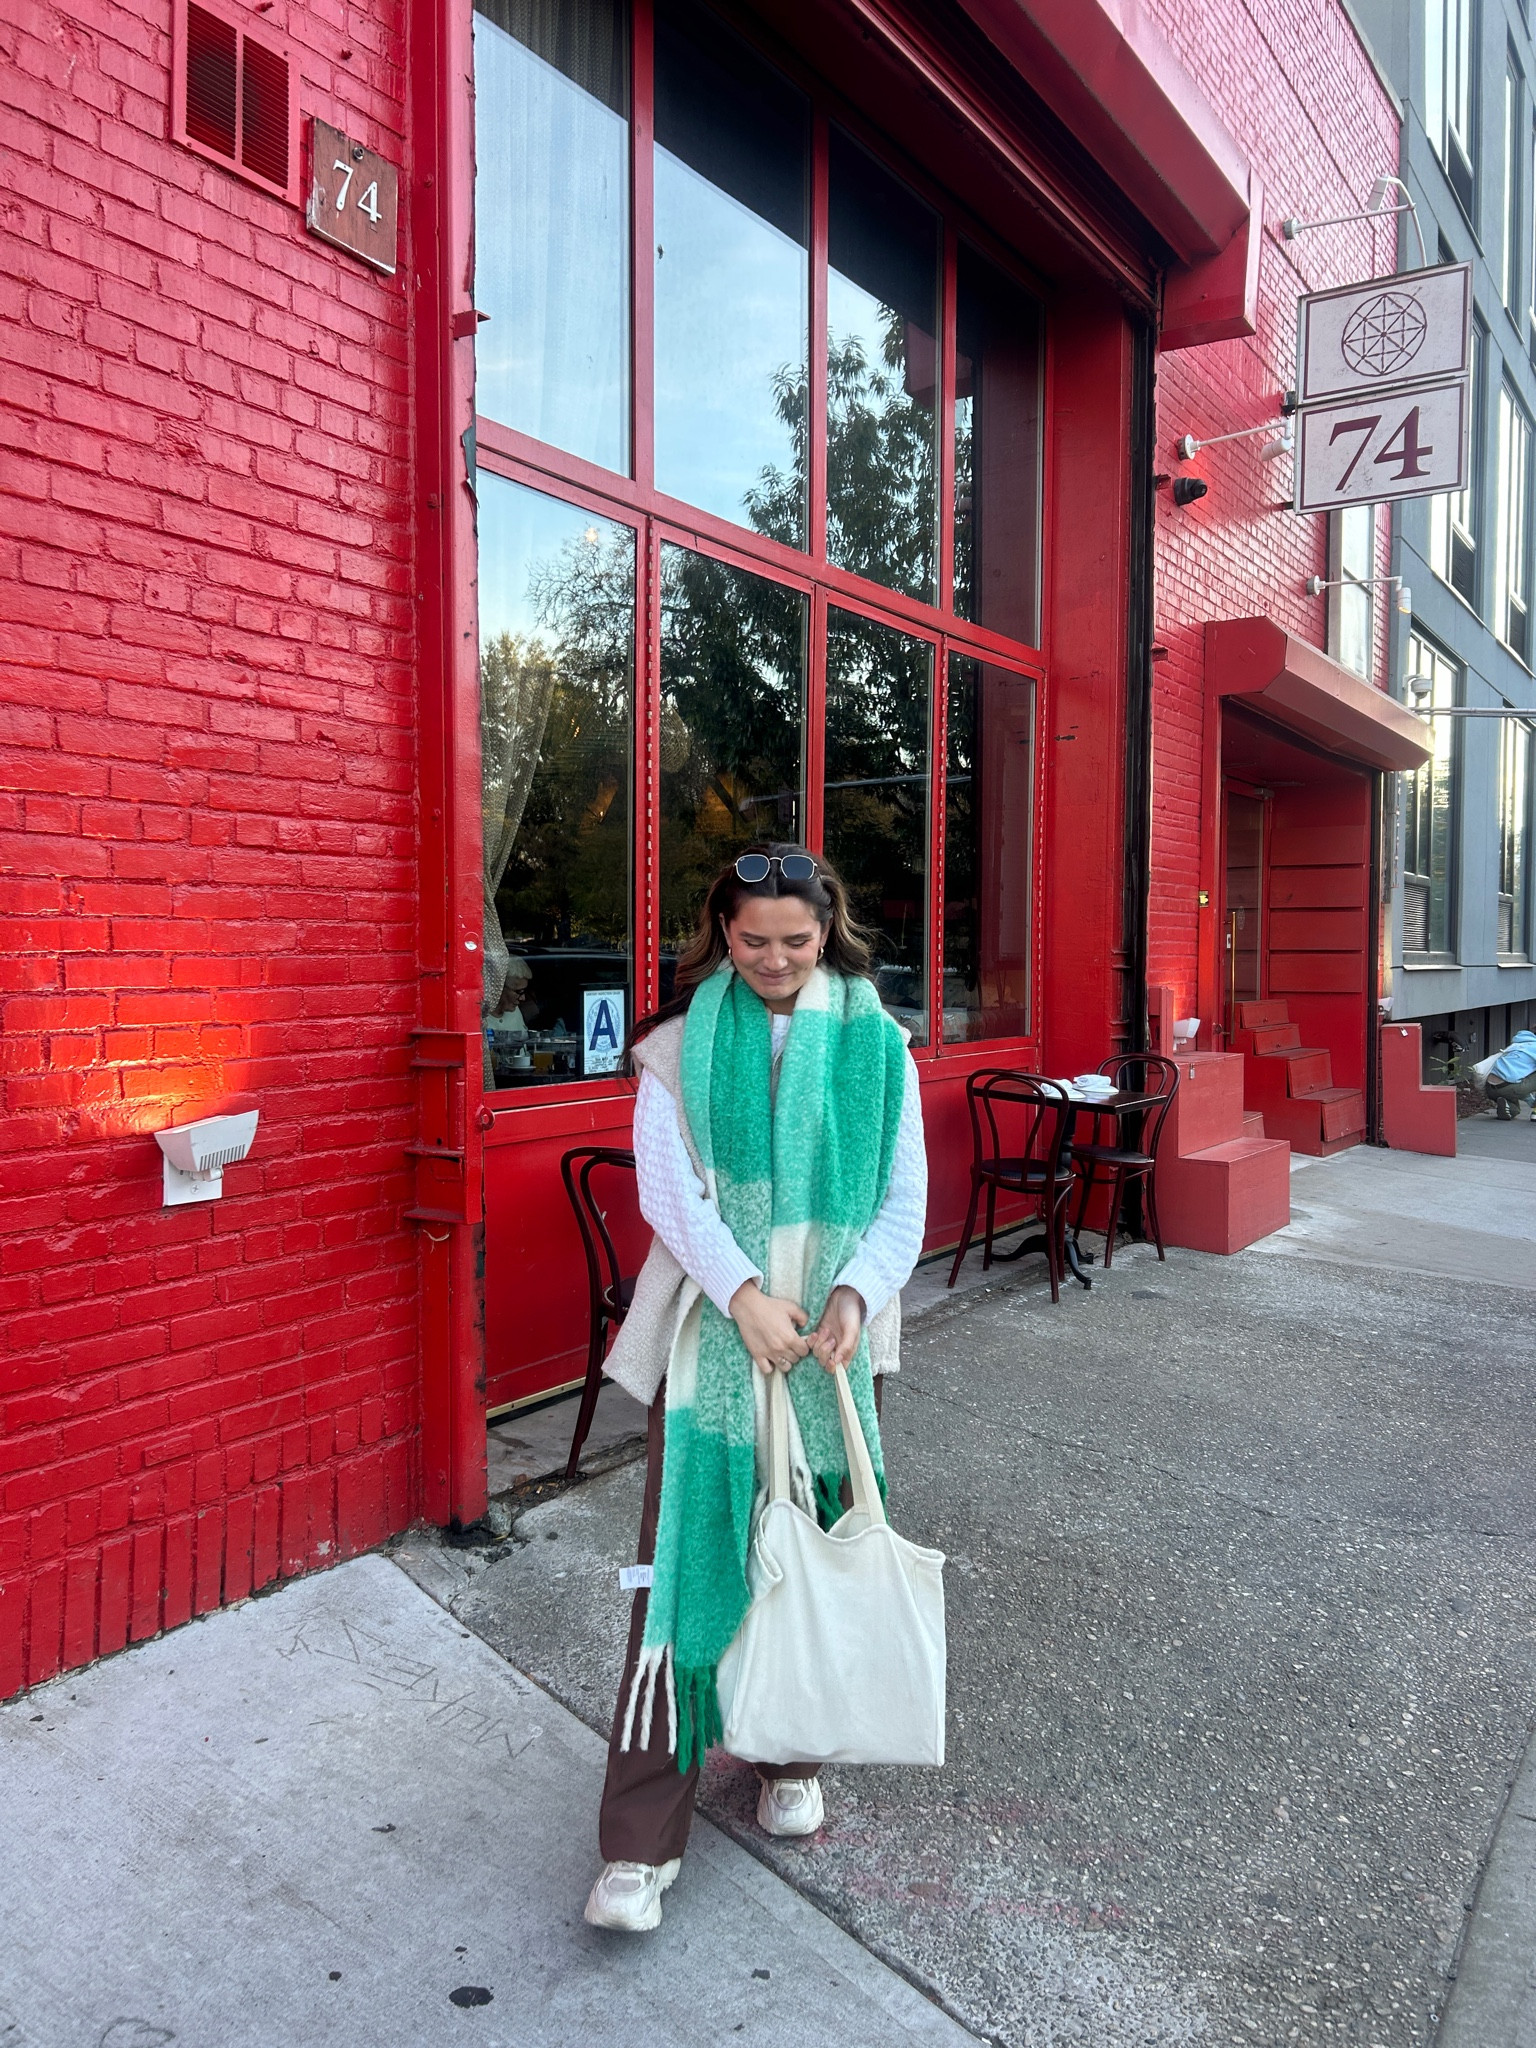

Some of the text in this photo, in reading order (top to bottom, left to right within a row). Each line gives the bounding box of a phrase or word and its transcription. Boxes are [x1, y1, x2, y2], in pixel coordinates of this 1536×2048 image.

[332, 159, 383, 223] 74
[1328, 405, 1434, 492] 74
[588, 999, 618, 1051] A
